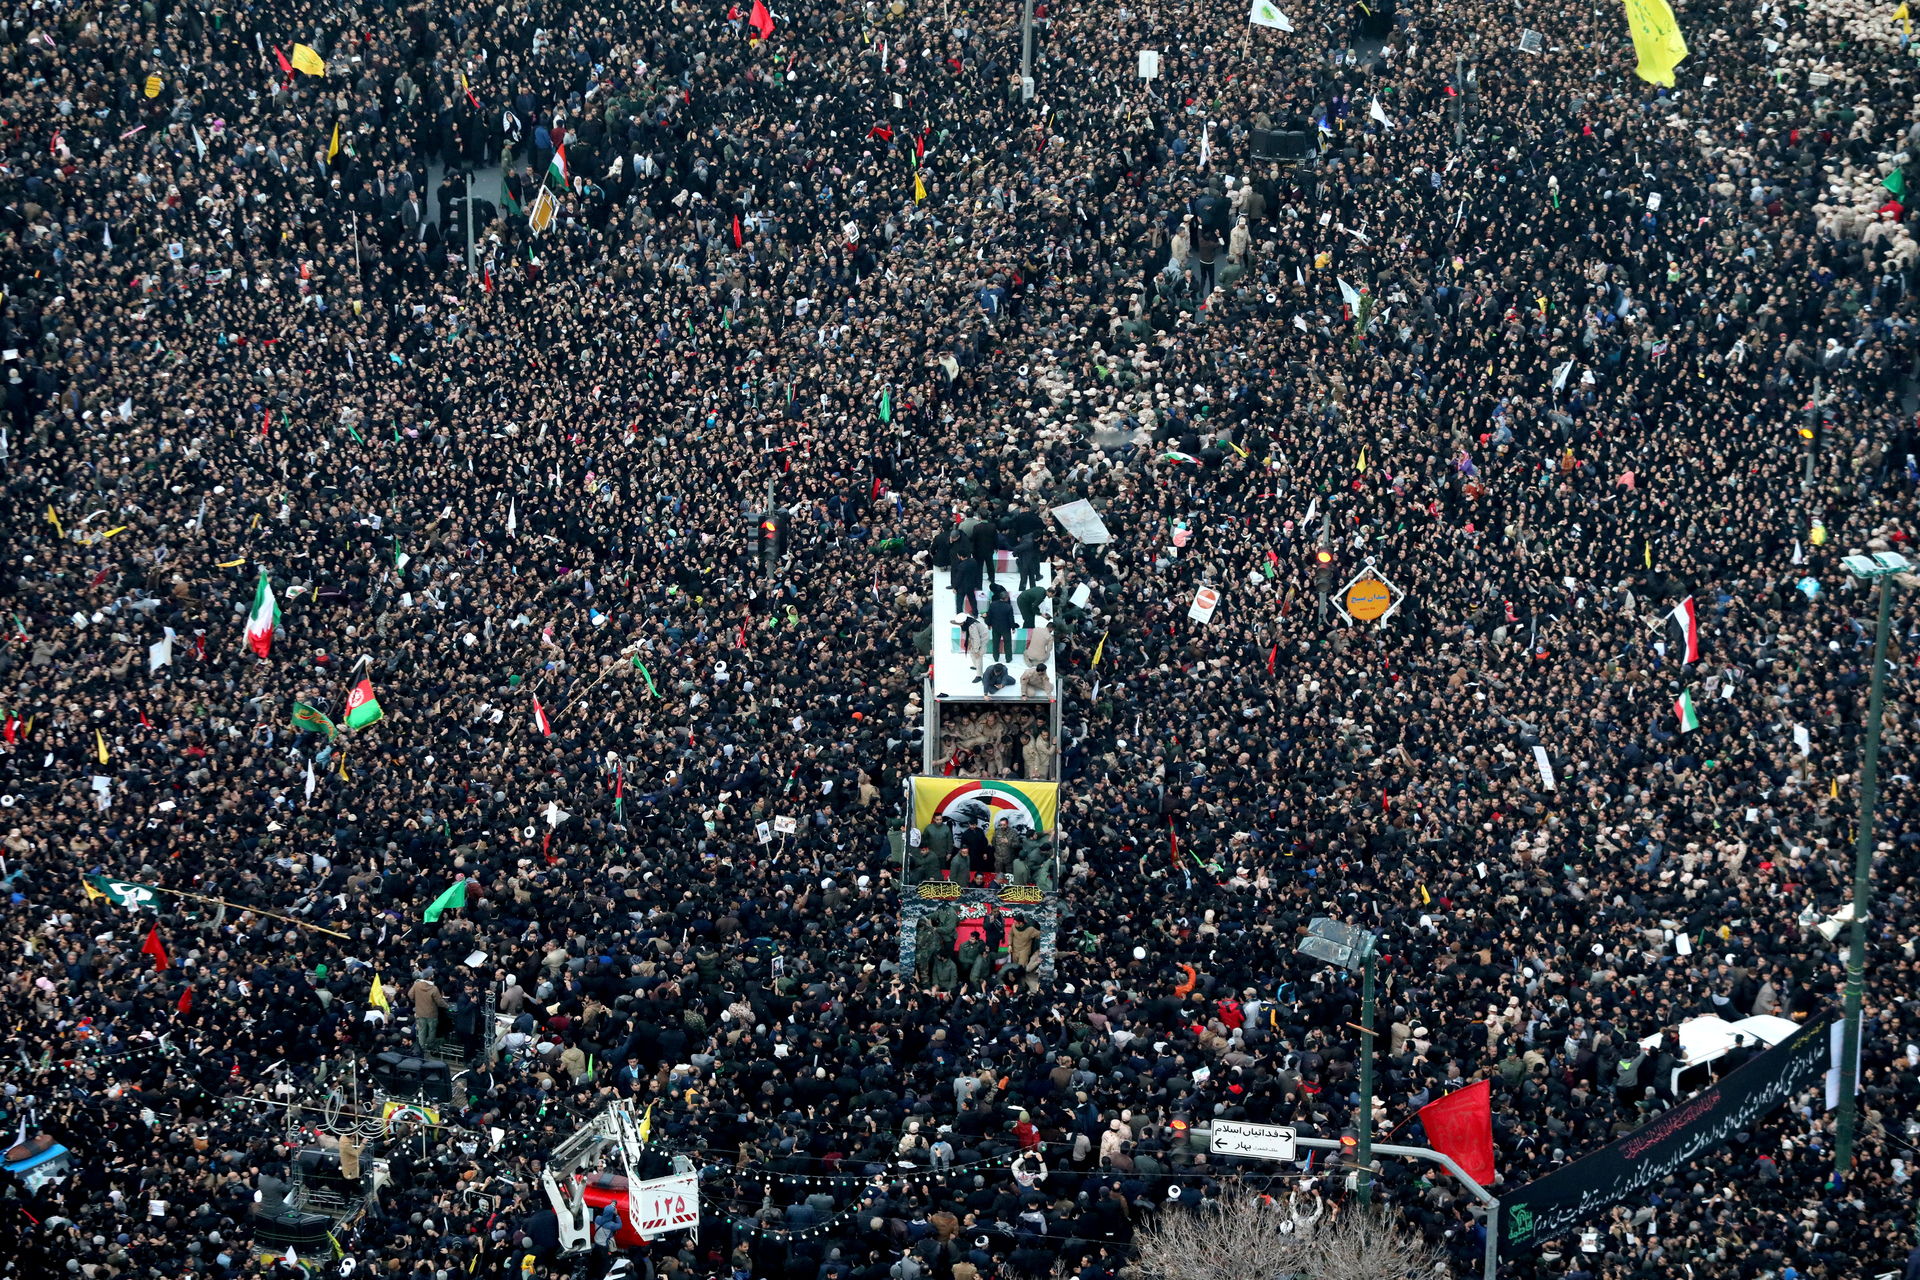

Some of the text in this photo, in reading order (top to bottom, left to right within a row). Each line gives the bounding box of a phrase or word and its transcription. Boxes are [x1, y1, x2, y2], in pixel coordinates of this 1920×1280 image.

[1214, 1124, 1242, 1136] اسلام
[1234, 1141, 1252, 1152] بهار
[654, 1195, 686, 1218] ۱۲۵
